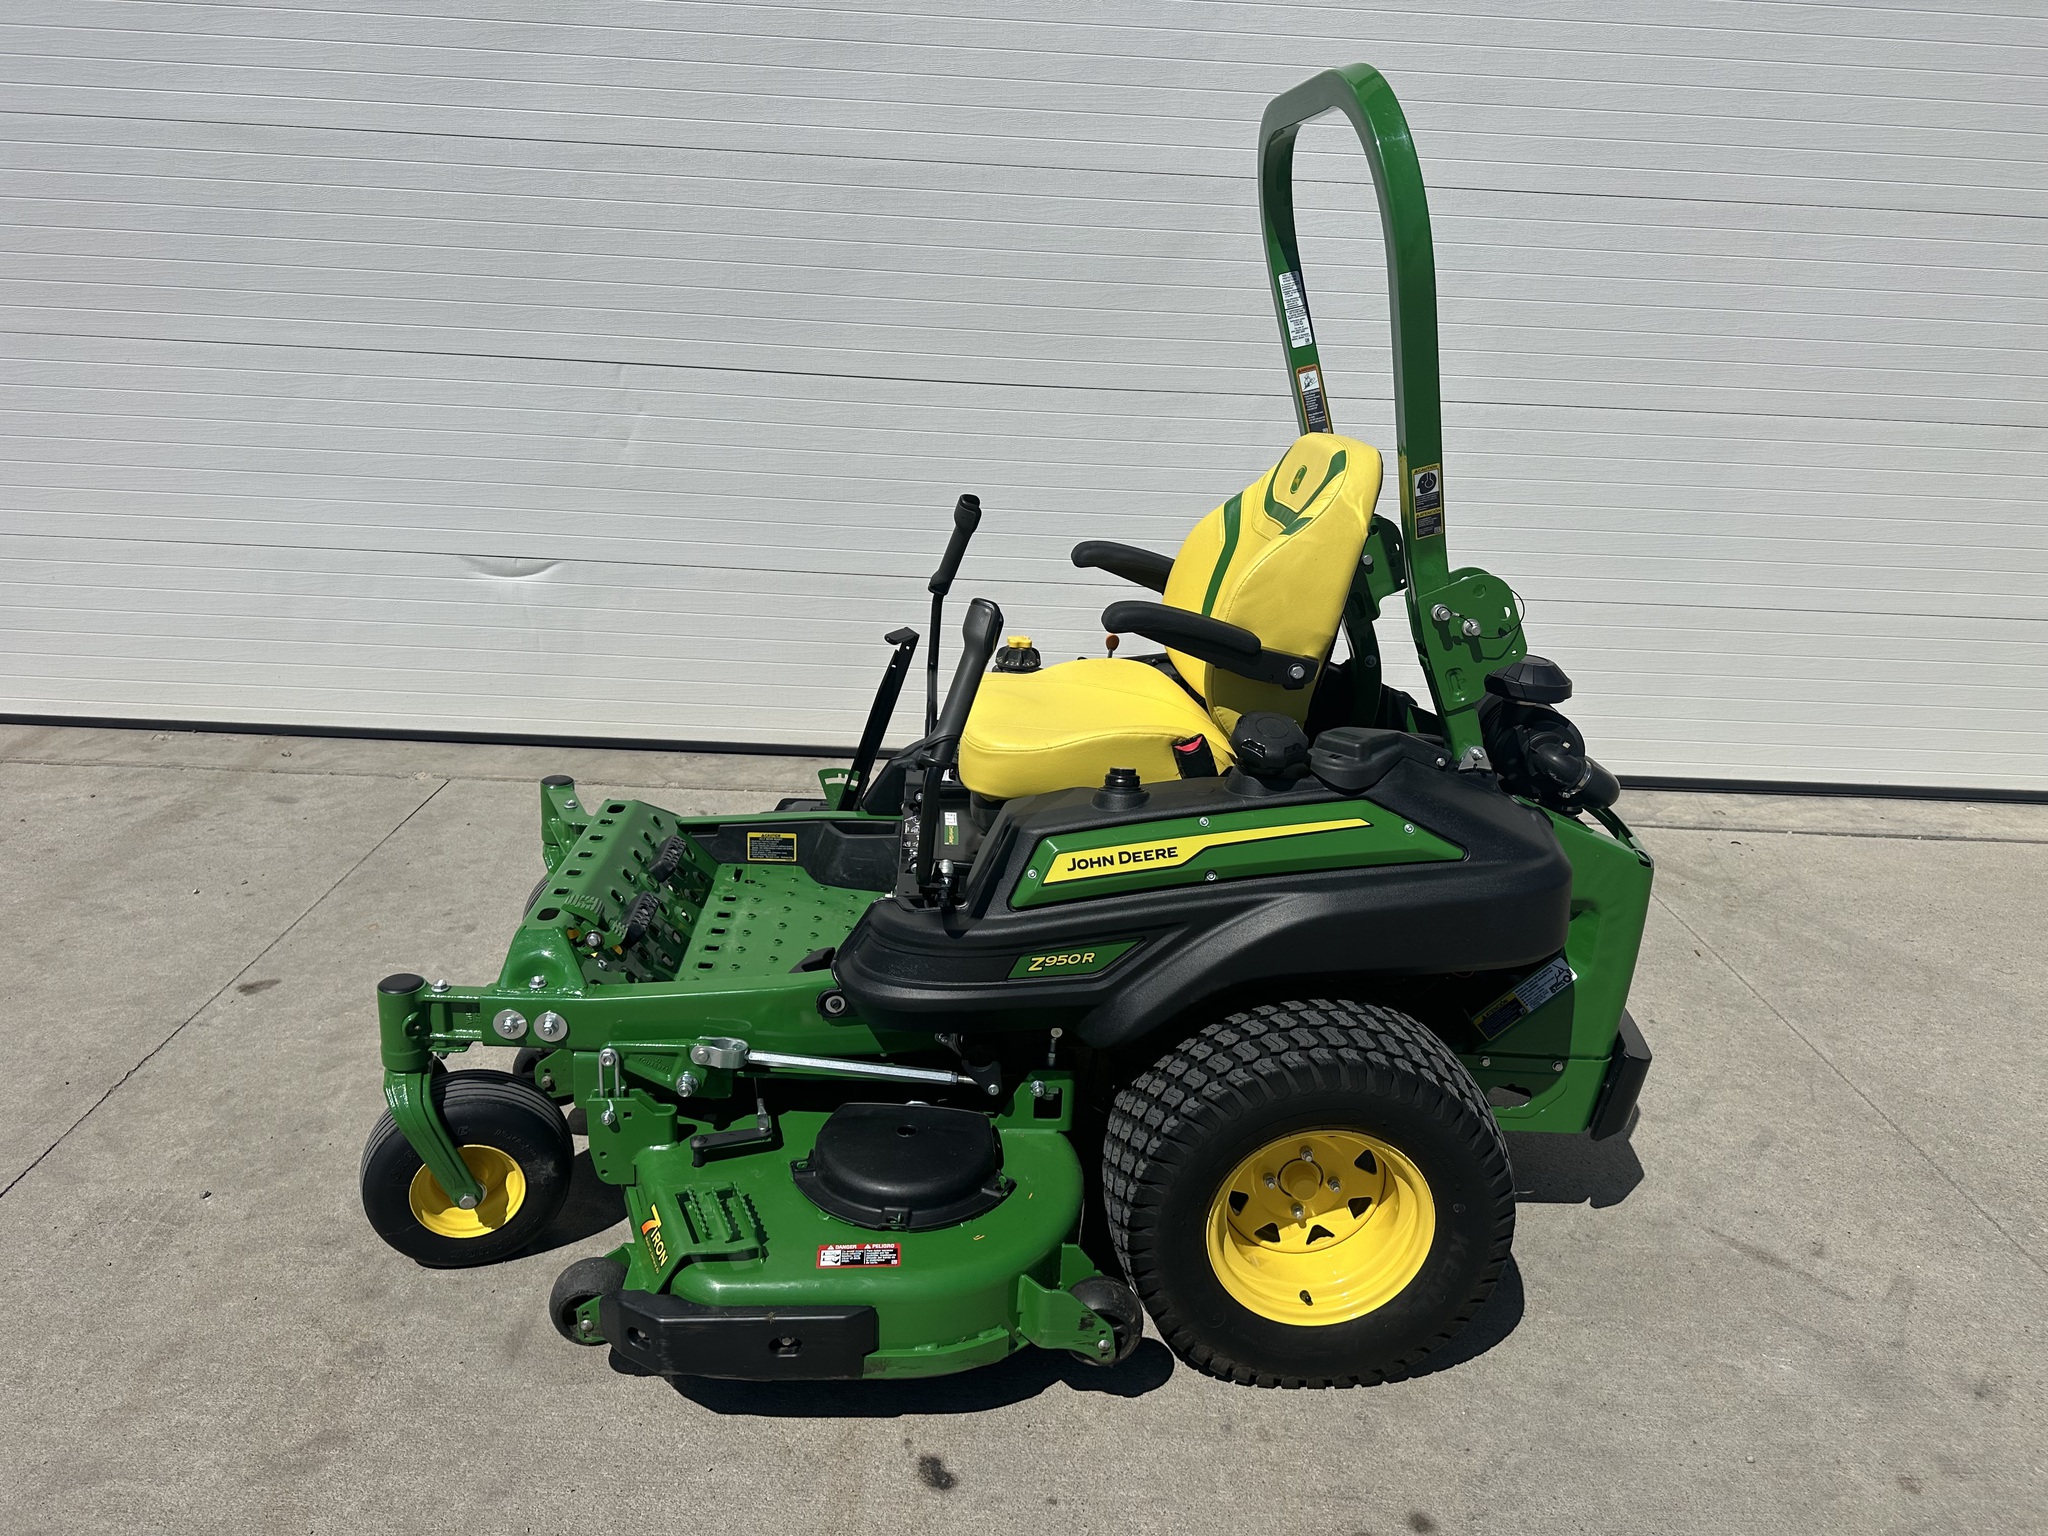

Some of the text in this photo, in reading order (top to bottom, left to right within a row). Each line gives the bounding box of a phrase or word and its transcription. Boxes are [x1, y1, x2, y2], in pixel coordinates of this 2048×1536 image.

[1067, 846, 1179, 872] JOHN DEERE
[1027, 952, 1096, 972] Z950R
